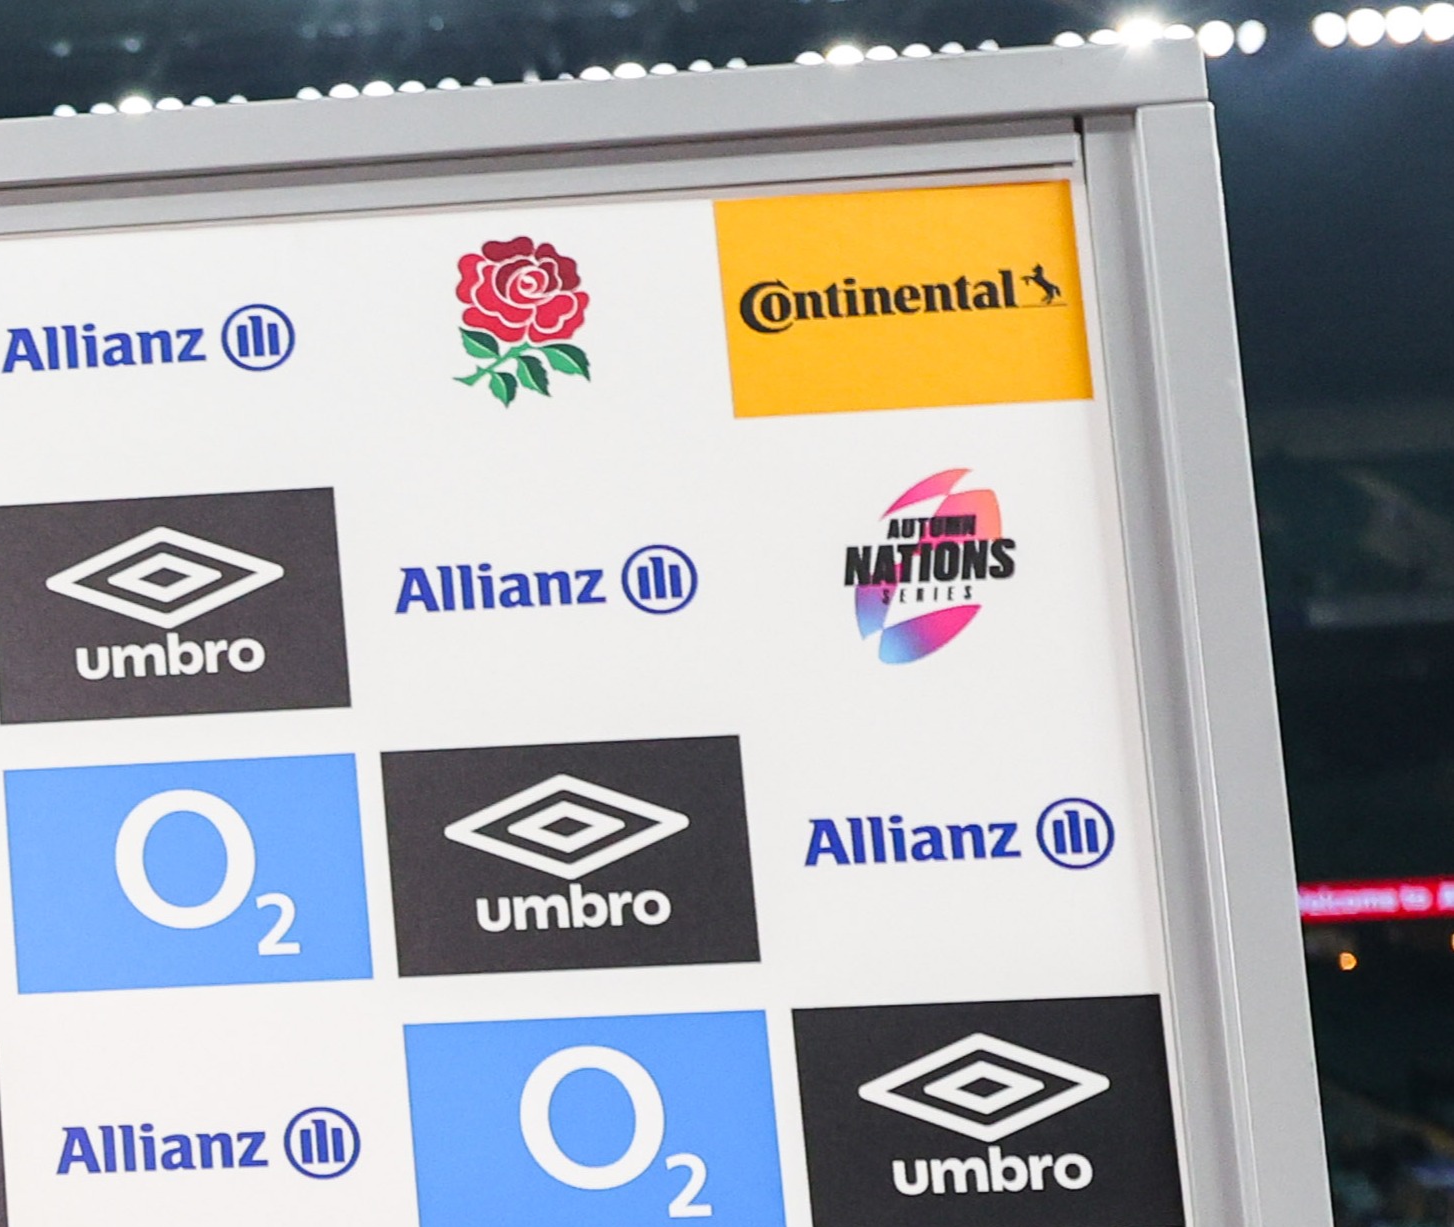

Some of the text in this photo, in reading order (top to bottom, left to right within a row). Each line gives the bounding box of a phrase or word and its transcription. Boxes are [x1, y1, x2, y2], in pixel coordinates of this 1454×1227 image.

[739, 270, 1017, 334] Continental
[2, 323, 207, 374] Allianz
[886, 514, 977, 540] AUTUMN
[843, 537, 1016, 587] NATIONS
[395, 562, 607, 614] Allianz
[881, 585, 973, 606] SERIES
[76, 632, 265, 680] umbro
[805, 814, 1021, 867] Allianz
[476, 883, 671, 932] umbro
[57, 1123, 269, 1175] Allianz
[892, 1146, 1093, 1195] umbro
